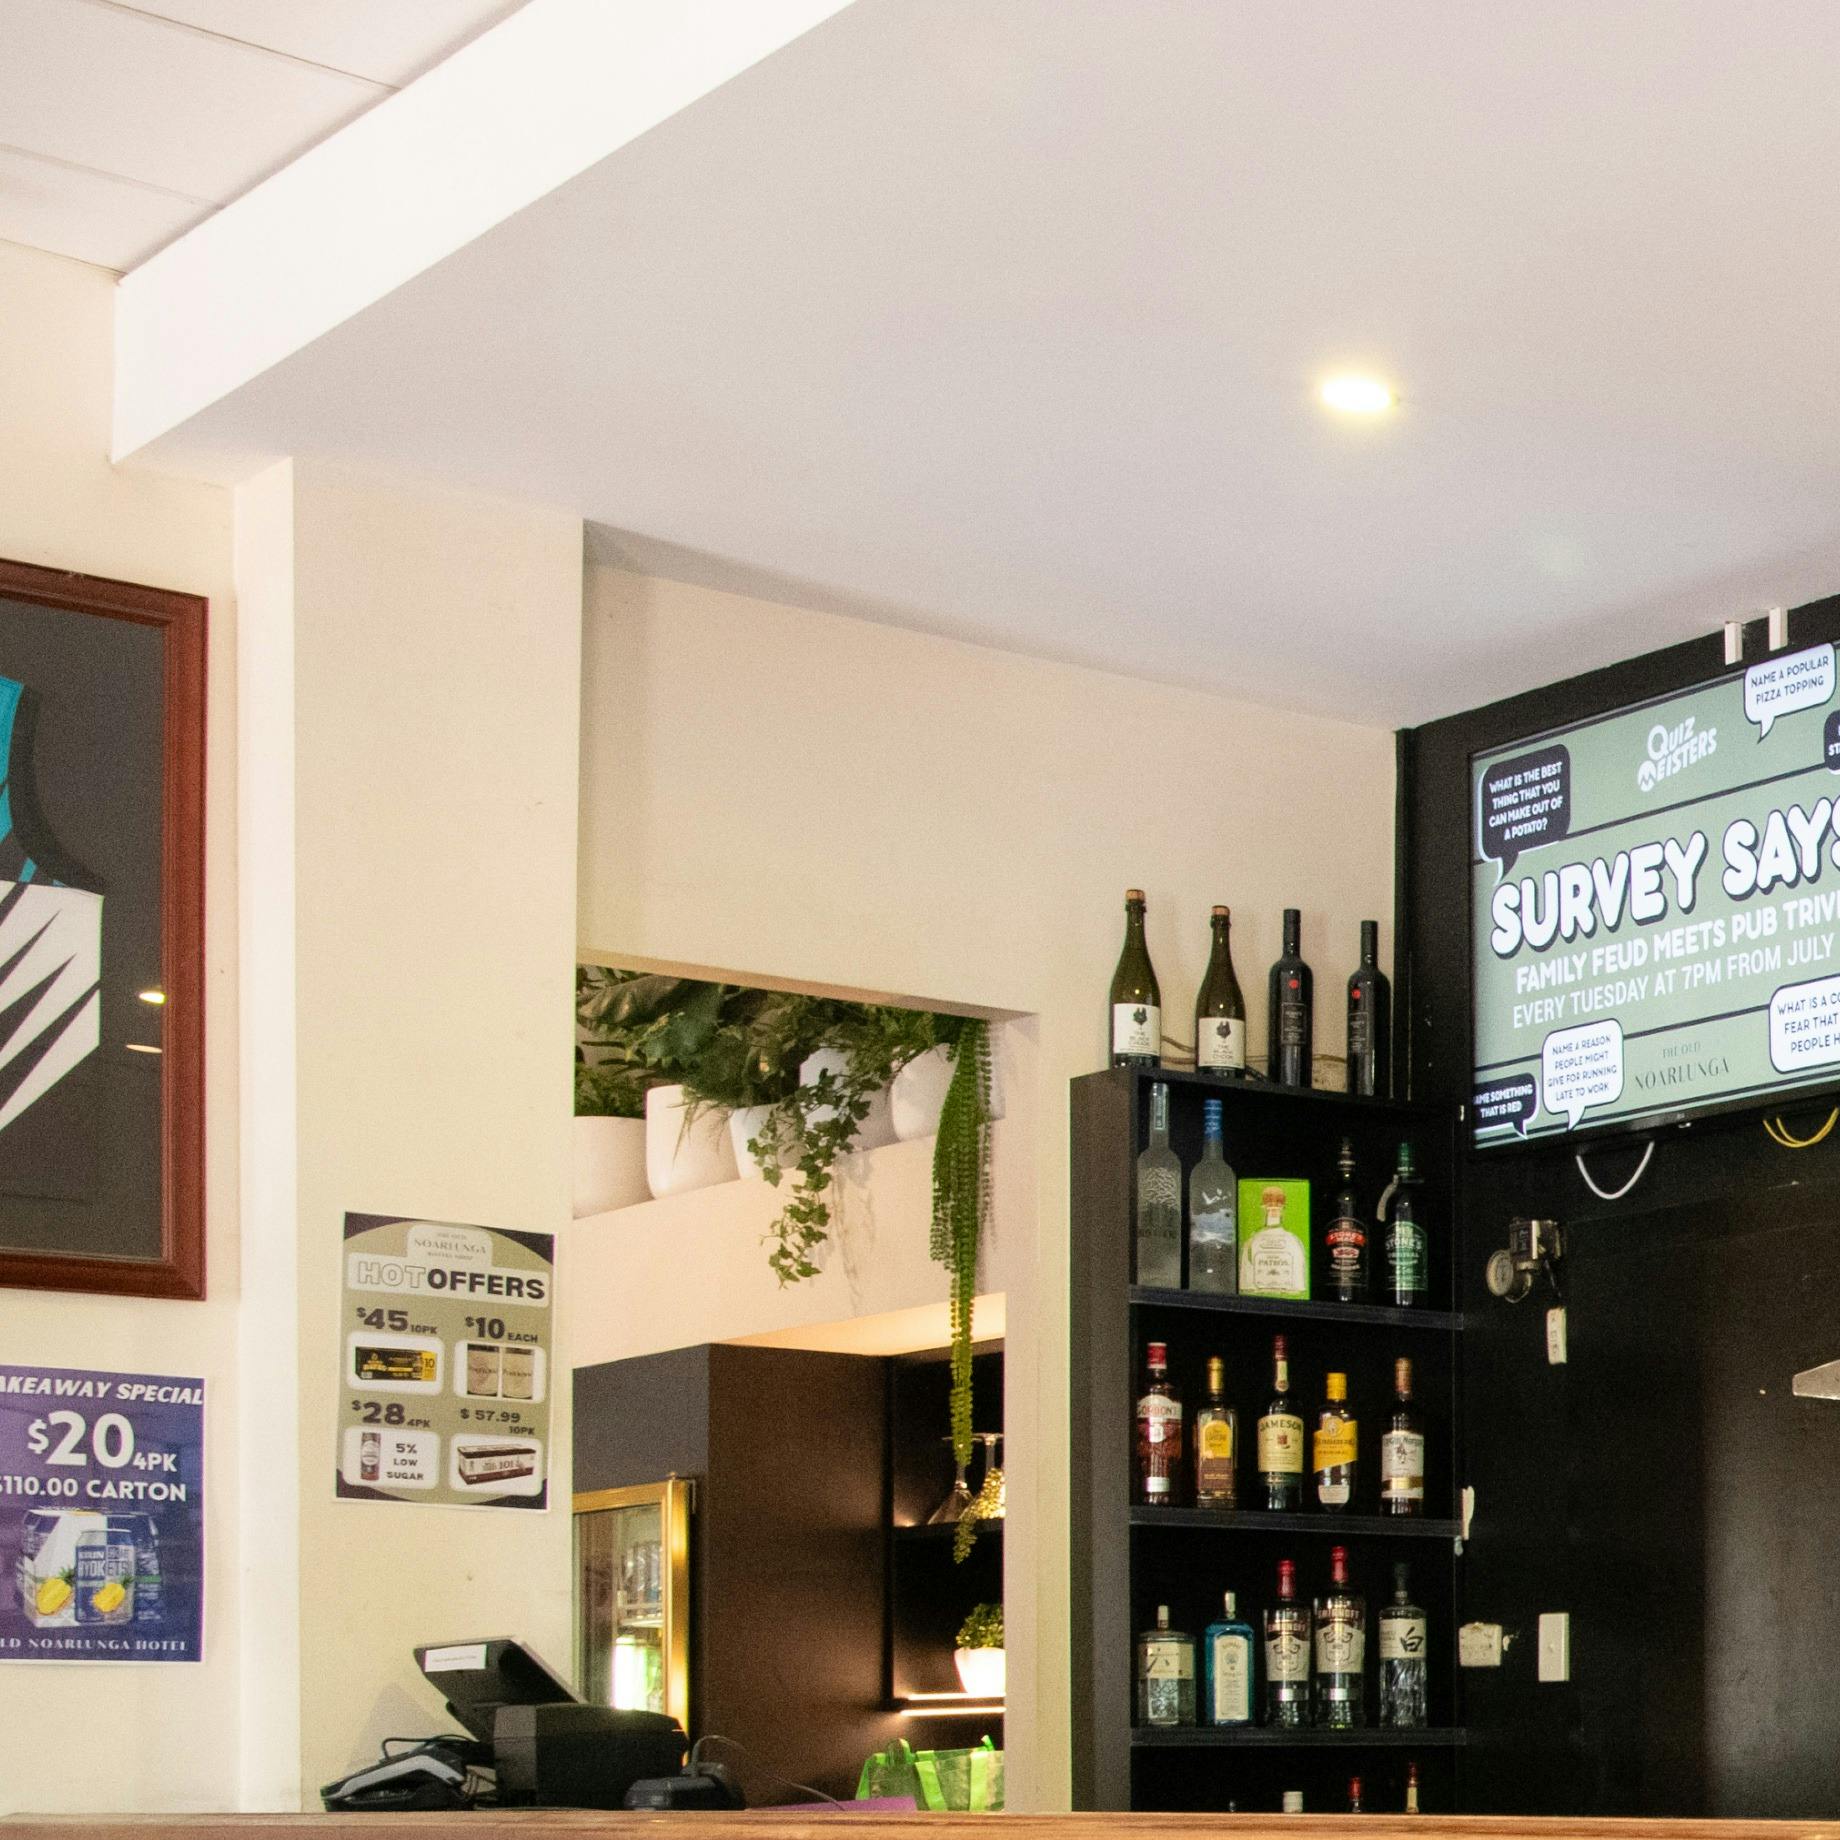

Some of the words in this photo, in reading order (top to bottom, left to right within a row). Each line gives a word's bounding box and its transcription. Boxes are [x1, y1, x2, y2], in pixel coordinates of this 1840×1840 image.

[1751, 671, 1776, 688] NAME
[1787, 655, 1829, 677] POPULAR
[1756, 688, 1782, 705] PIZZA
[1784, 675, 1824, 698] TOPPING
[1646, 716, 1695, 760] QUIZ
[1637, 728, 1717, 792] MEISTERS
[1489, 777, 1513, 793] WHAT
[1514, 775, 1521, 787] IS
[1523, 769, 1540, 785] THE
[1542, 762, 1562, 779] BEST
[1492, 793, 1518, 810] THING
[1518, 787, 1541, 805] THAT
[1542, 781, 1560, 799] YOU
[1489, 813, 1506, 827] CAN
[1508, 807, 1531, 824] MAKE
[1532, 801, 1549, 817] OUT
[1551, 795, 1563, 809] OF
[1512, 818, 1548, 839] POTATO?
[1491, 831, 1708, 959] SURVEY
[1516, 952, 1587, 994] FAMILY
[1591, 938, 1648, 976] FEUD
[1653, 918, 1726, 962] MEETS
[1731, 907, 1778, 942] PUB
[1513, 998, 1564, 1028] EVERY
[1570, 976, 1648, 1014] TUESDAY
[1653, 970, 1675, 993] AT
[1682, 957, 1722, 989] 7PM
[1726, 945, 1781, 980] FROM
[1787, 930, 1835, 967] JULY
[1777, 999, 1806, 1015] WHAT
[1810, 997, 1818, 1009] IS
[1784, 1020, 1810, 1035] FEAR
[1813, 1013, 1838, 1028] THAT
[1552, 1044, 1574, 1055] NAME
[1581, 1035, 1611, 1050] REASON
[1790, 1034, 1830, 1053] PEOPLE
[1554, 1057, 1583, 1070] PEOPLE
[1585, 1050, 1609, 1064] MIGHT
[1548, 1075, 1565, 1087] GIVE
[1566, 1072, 1581, 1084] FOR
[1582, 1064, 1617, 1080] RUNNING
[1635, 1057, 1730, 1090] NOARLUNGA
[1491, 1084, 1533, 1102] SOMETHING
[1556, 1089, 1574, 1101] LATE
[1576, 1087, 1586, 1097] TO
[1588, 1082, 1609, 1095] WORK
[1480, 1106, 1499, 1119] THAT
[1507, 1101, 1523, 1114] RED
[356, 1307, 408, 1331] $45
[410, 1324, 437, 1335] 10PK
[465, 1316, 505, 1339] $10
[507, 1332, 538, 1343] EACH
[116, 1383, 204, 1405] SPECIAL
[351, 1400, 405, 1425] $28
[407, 1418, 431, 1428] 4PK
[475, 1409, 521, 1423] 57.99
[509, 1426, 535, 1435] 10PK
[1260, 1420, 1303, 1432] JAMESON
[28, 1410, 134, 1468] $20
[133, 1452, 177, 1472] 4PK
[395, 1443, 417, 1454] 5%
[394, 1458, 418, 1467] LOW
[386, 1471, 424, 1480] SUGAR
[87, 1479, 186, 1502] CARTON
[28, 1638, 130, 1651] NOARLUNGA
[136, 1639, 187, 1652] HOTEL
[1400, 1626, 1424, 1653] 白
